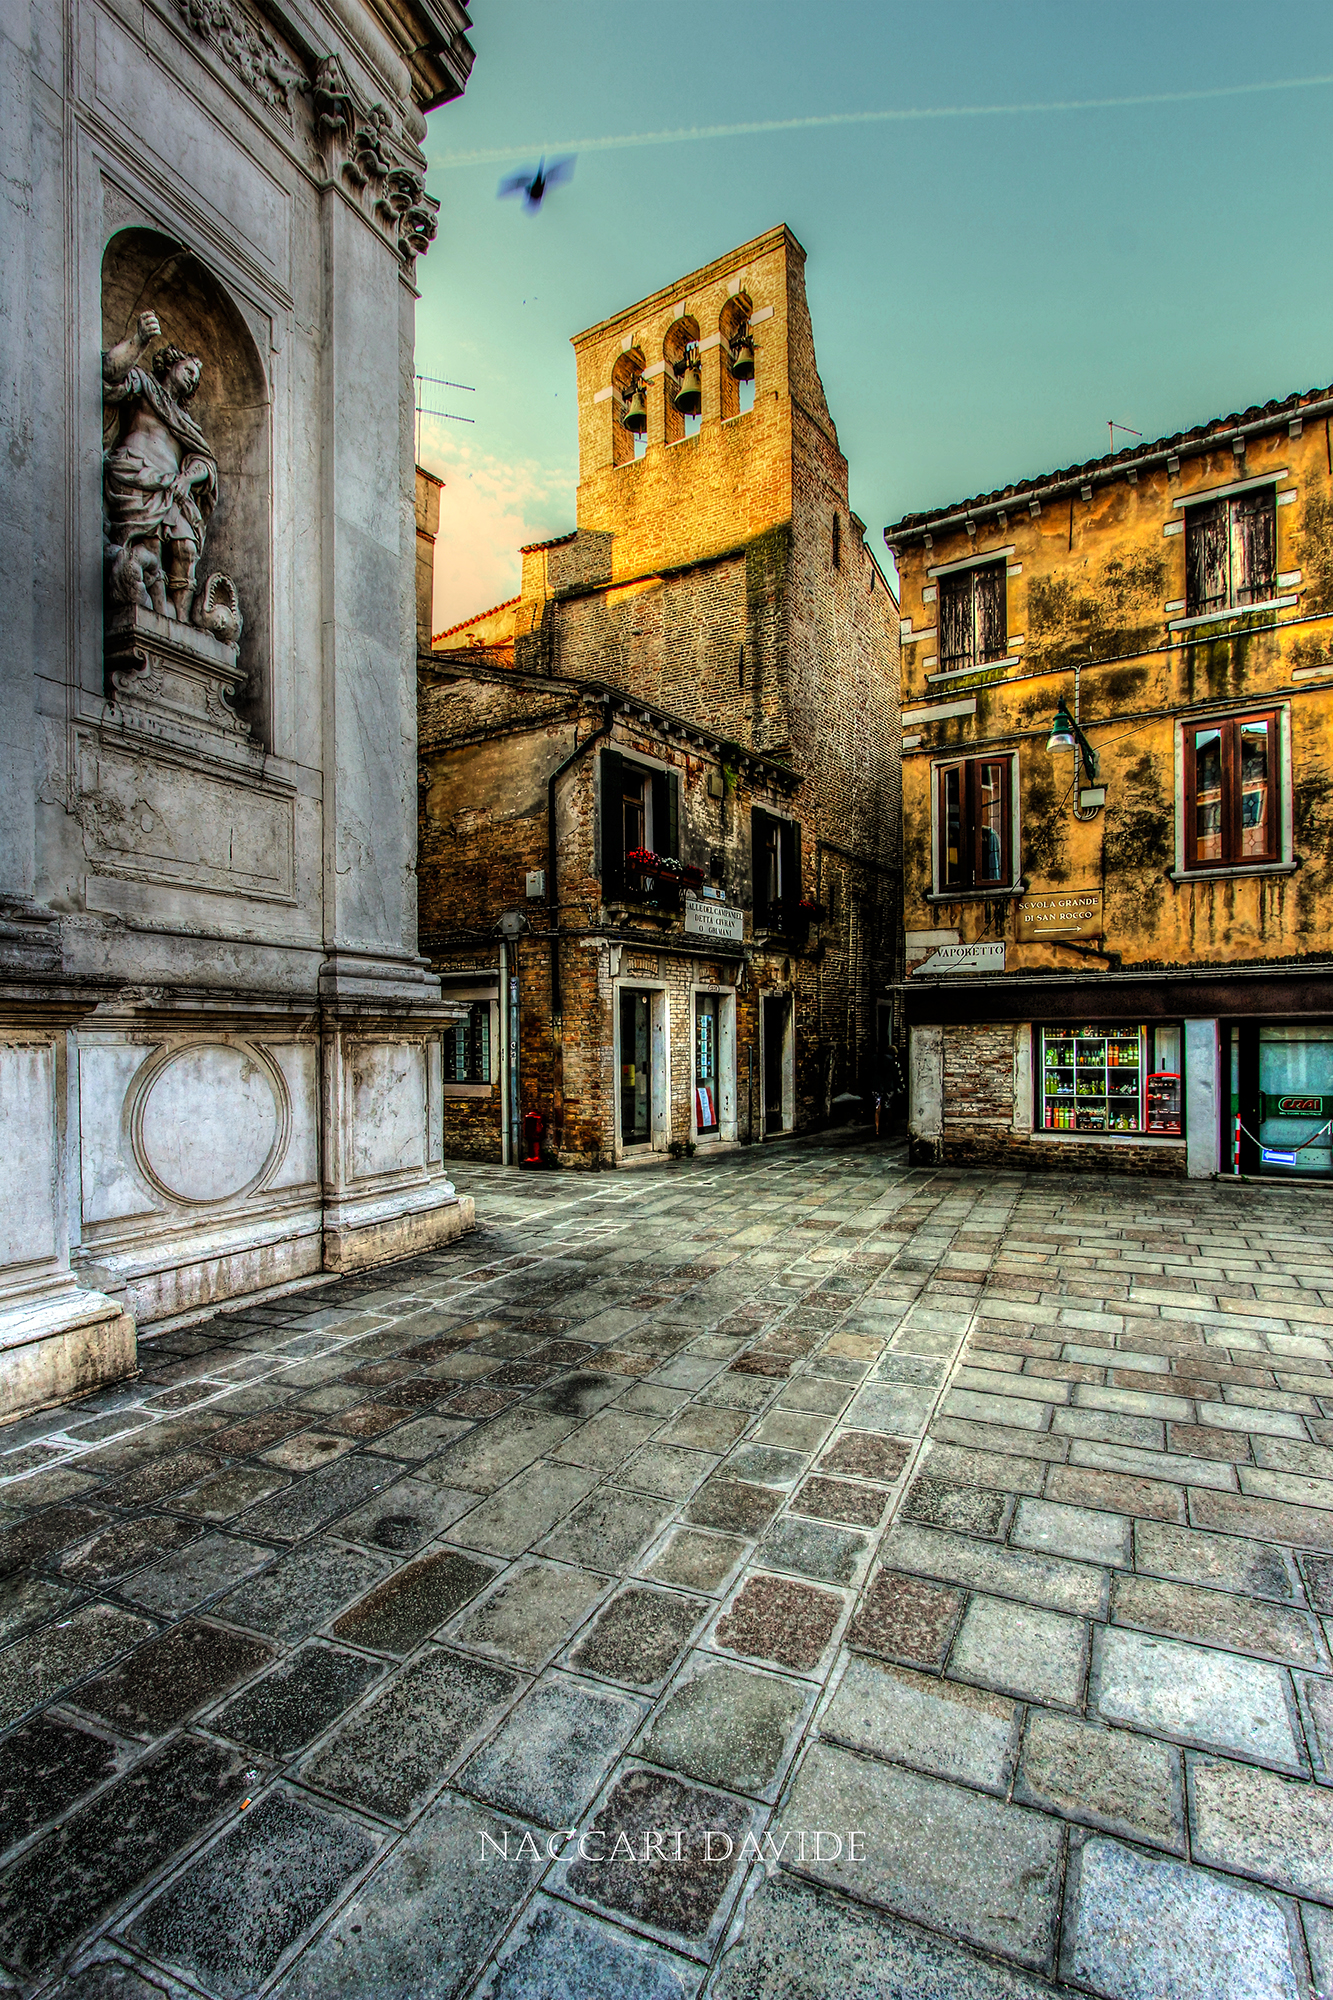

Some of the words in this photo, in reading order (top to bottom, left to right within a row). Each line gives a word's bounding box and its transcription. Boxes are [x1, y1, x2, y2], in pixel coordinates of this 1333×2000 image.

[1058, 897, 1099, 907] GRANDE
[694, 914, 713, 924] DETTA
[1024, 914, 1034, 922] DI
[1036, 913, 1056, 921] SAN
[1059, 911, 1093, 920] ROCCO
[937, 946, 1004, 957] VAPORETTO
[1282, 1099, 1320, 1109] CRAI
